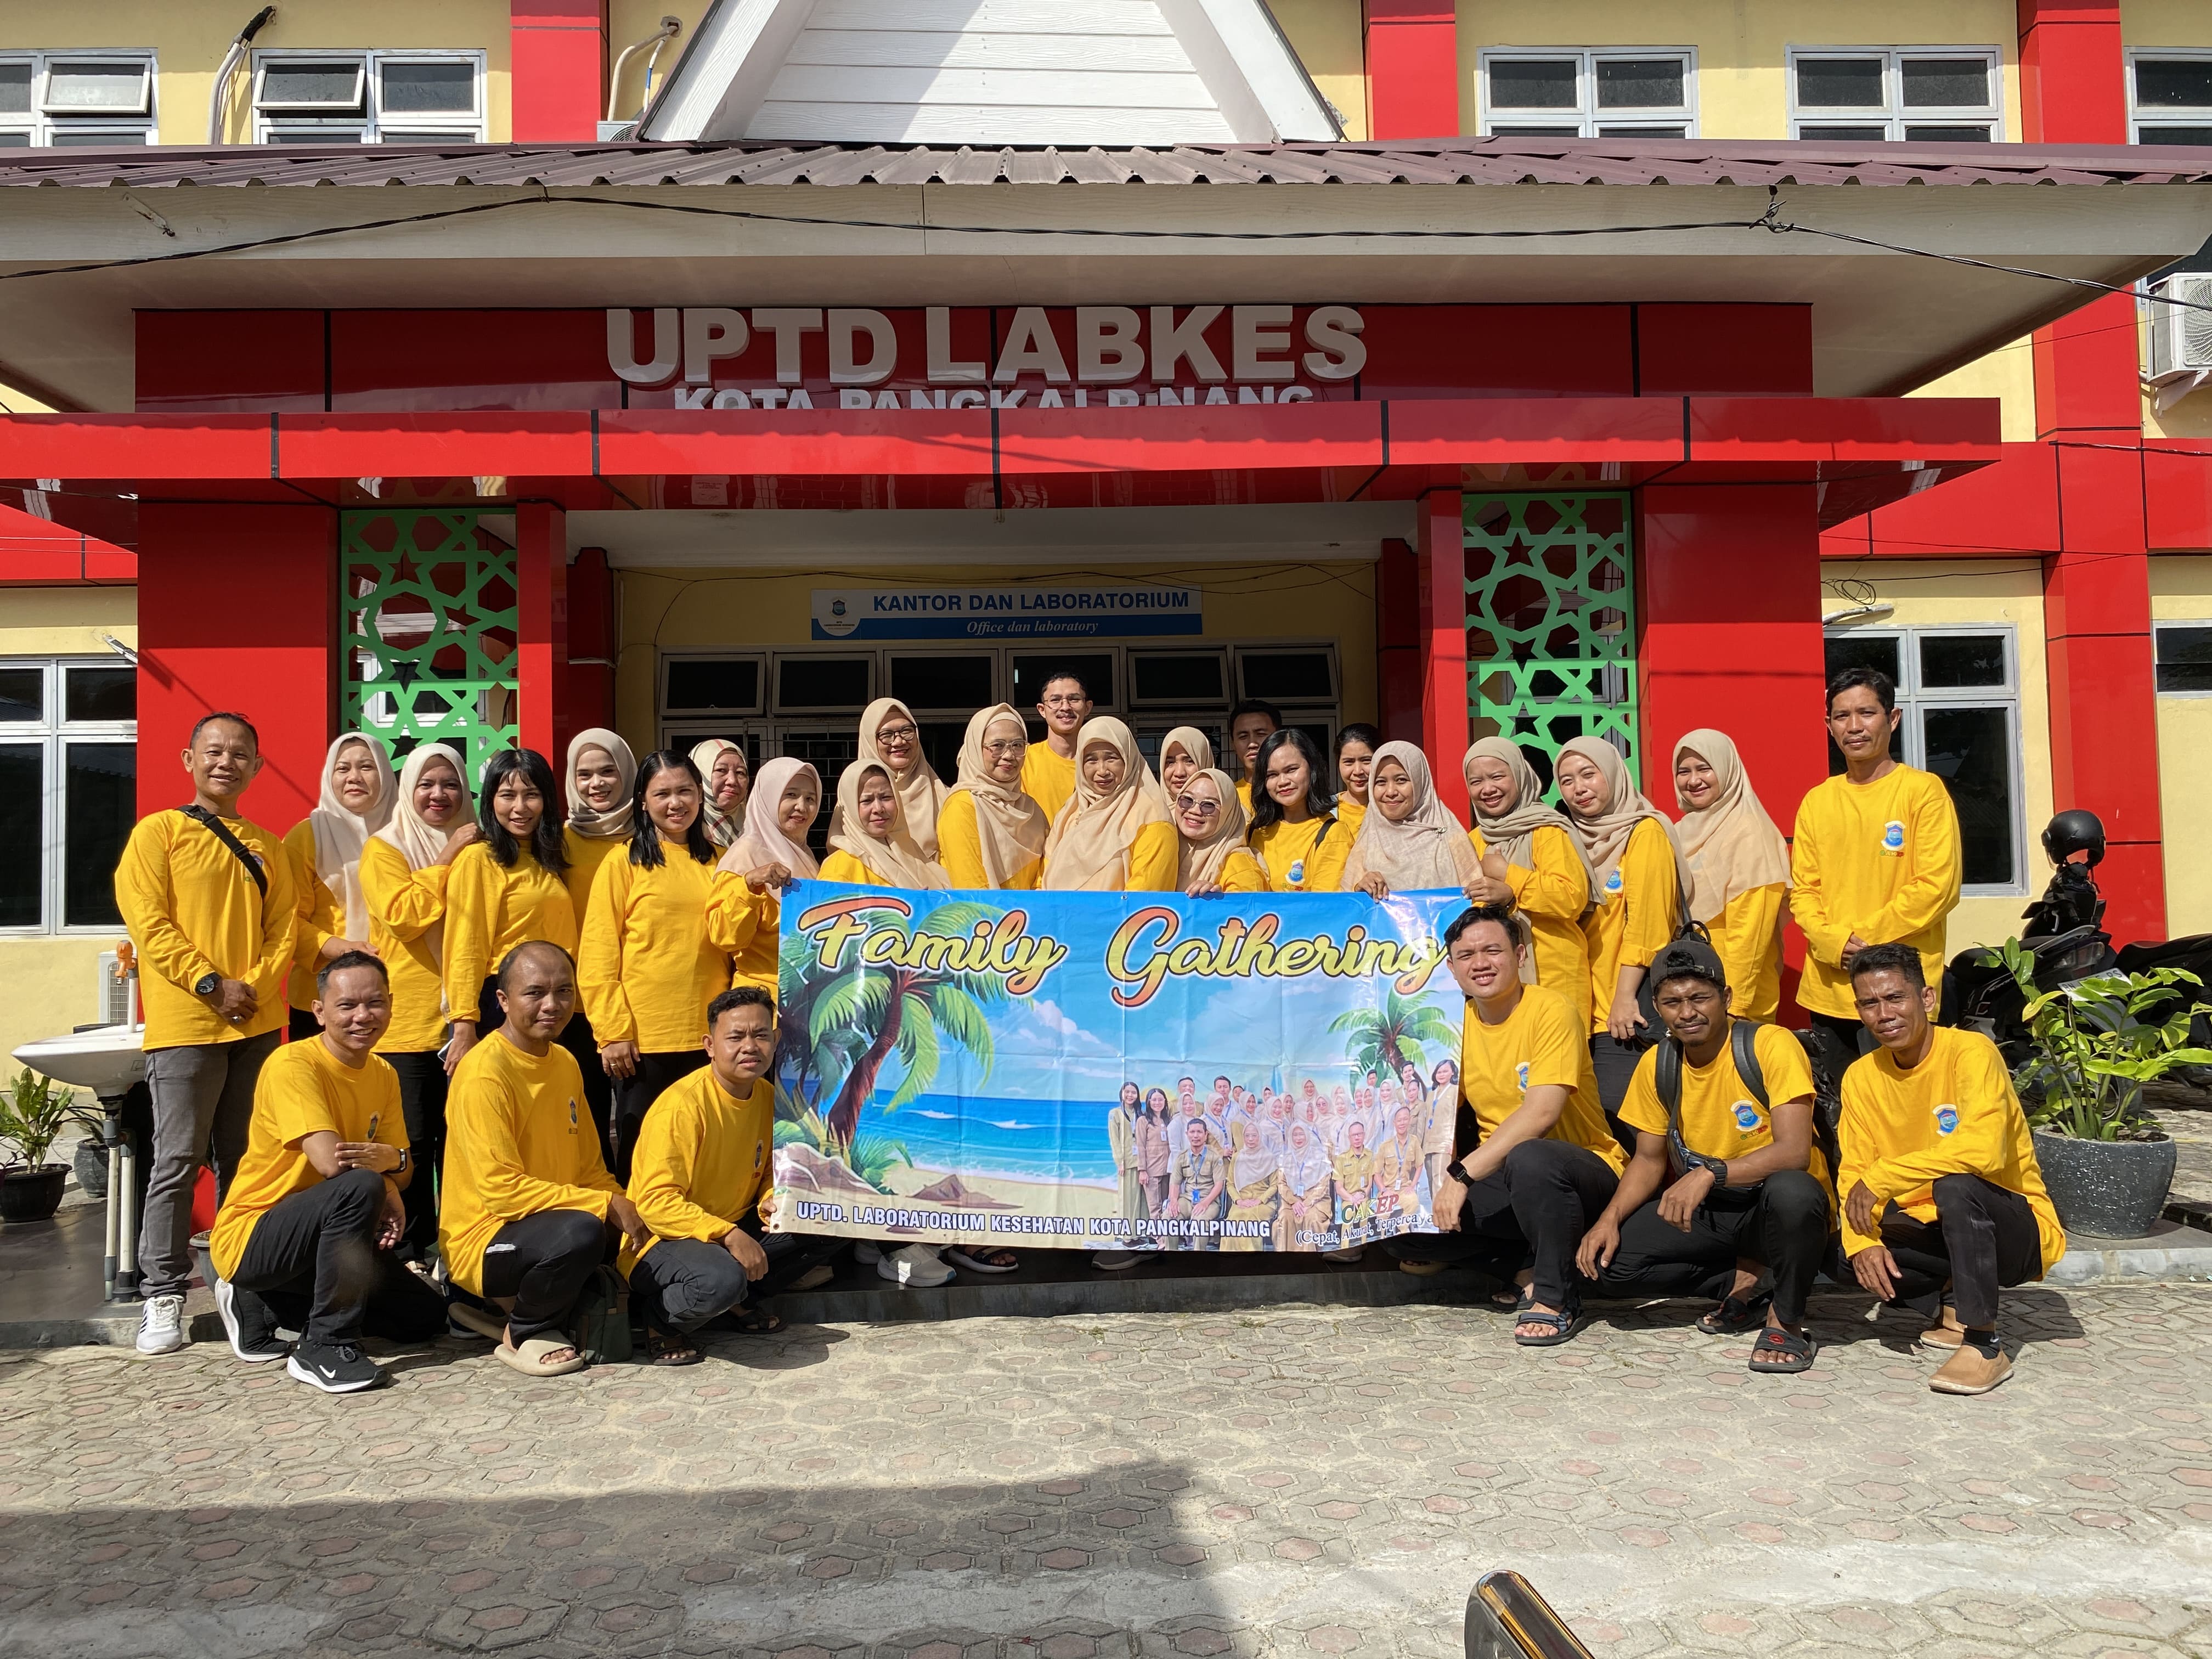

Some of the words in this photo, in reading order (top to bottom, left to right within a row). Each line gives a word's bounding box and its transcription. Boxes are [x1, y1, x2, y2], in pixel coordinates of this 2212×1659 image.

[606, 308, 898, 386] UPTD
[926, 306, 1367, 386] LABKES
[873, 595, 962, 612] KANTOR
[969, 594, 1013, 611] DAN
[1020, 591, 1189, 610] LABORATORIUM
[966, 620, 1004, 636] Office
[1007, 620, 1031, 633] dan
[1034, 620, 1098, 634] laboratory
[797, 896, 1068, 995] Family
[1105, 906, 1449, 1007] Gathering
[797, 1201, 849, 1223] UPTD.
[853, 1206, 985, 1231] LABORATORIUM
[990, 1214, 1085, 1235] KESEHATAN
[1090, 1217, 1132, 1236] KOTA
[1136, 1218, 1271, 1238] PANGKALPINANG
[1341, 1194, 1400, 1223] CAKEP
[1296, 1229, 1340, 1246] (Cepat,
